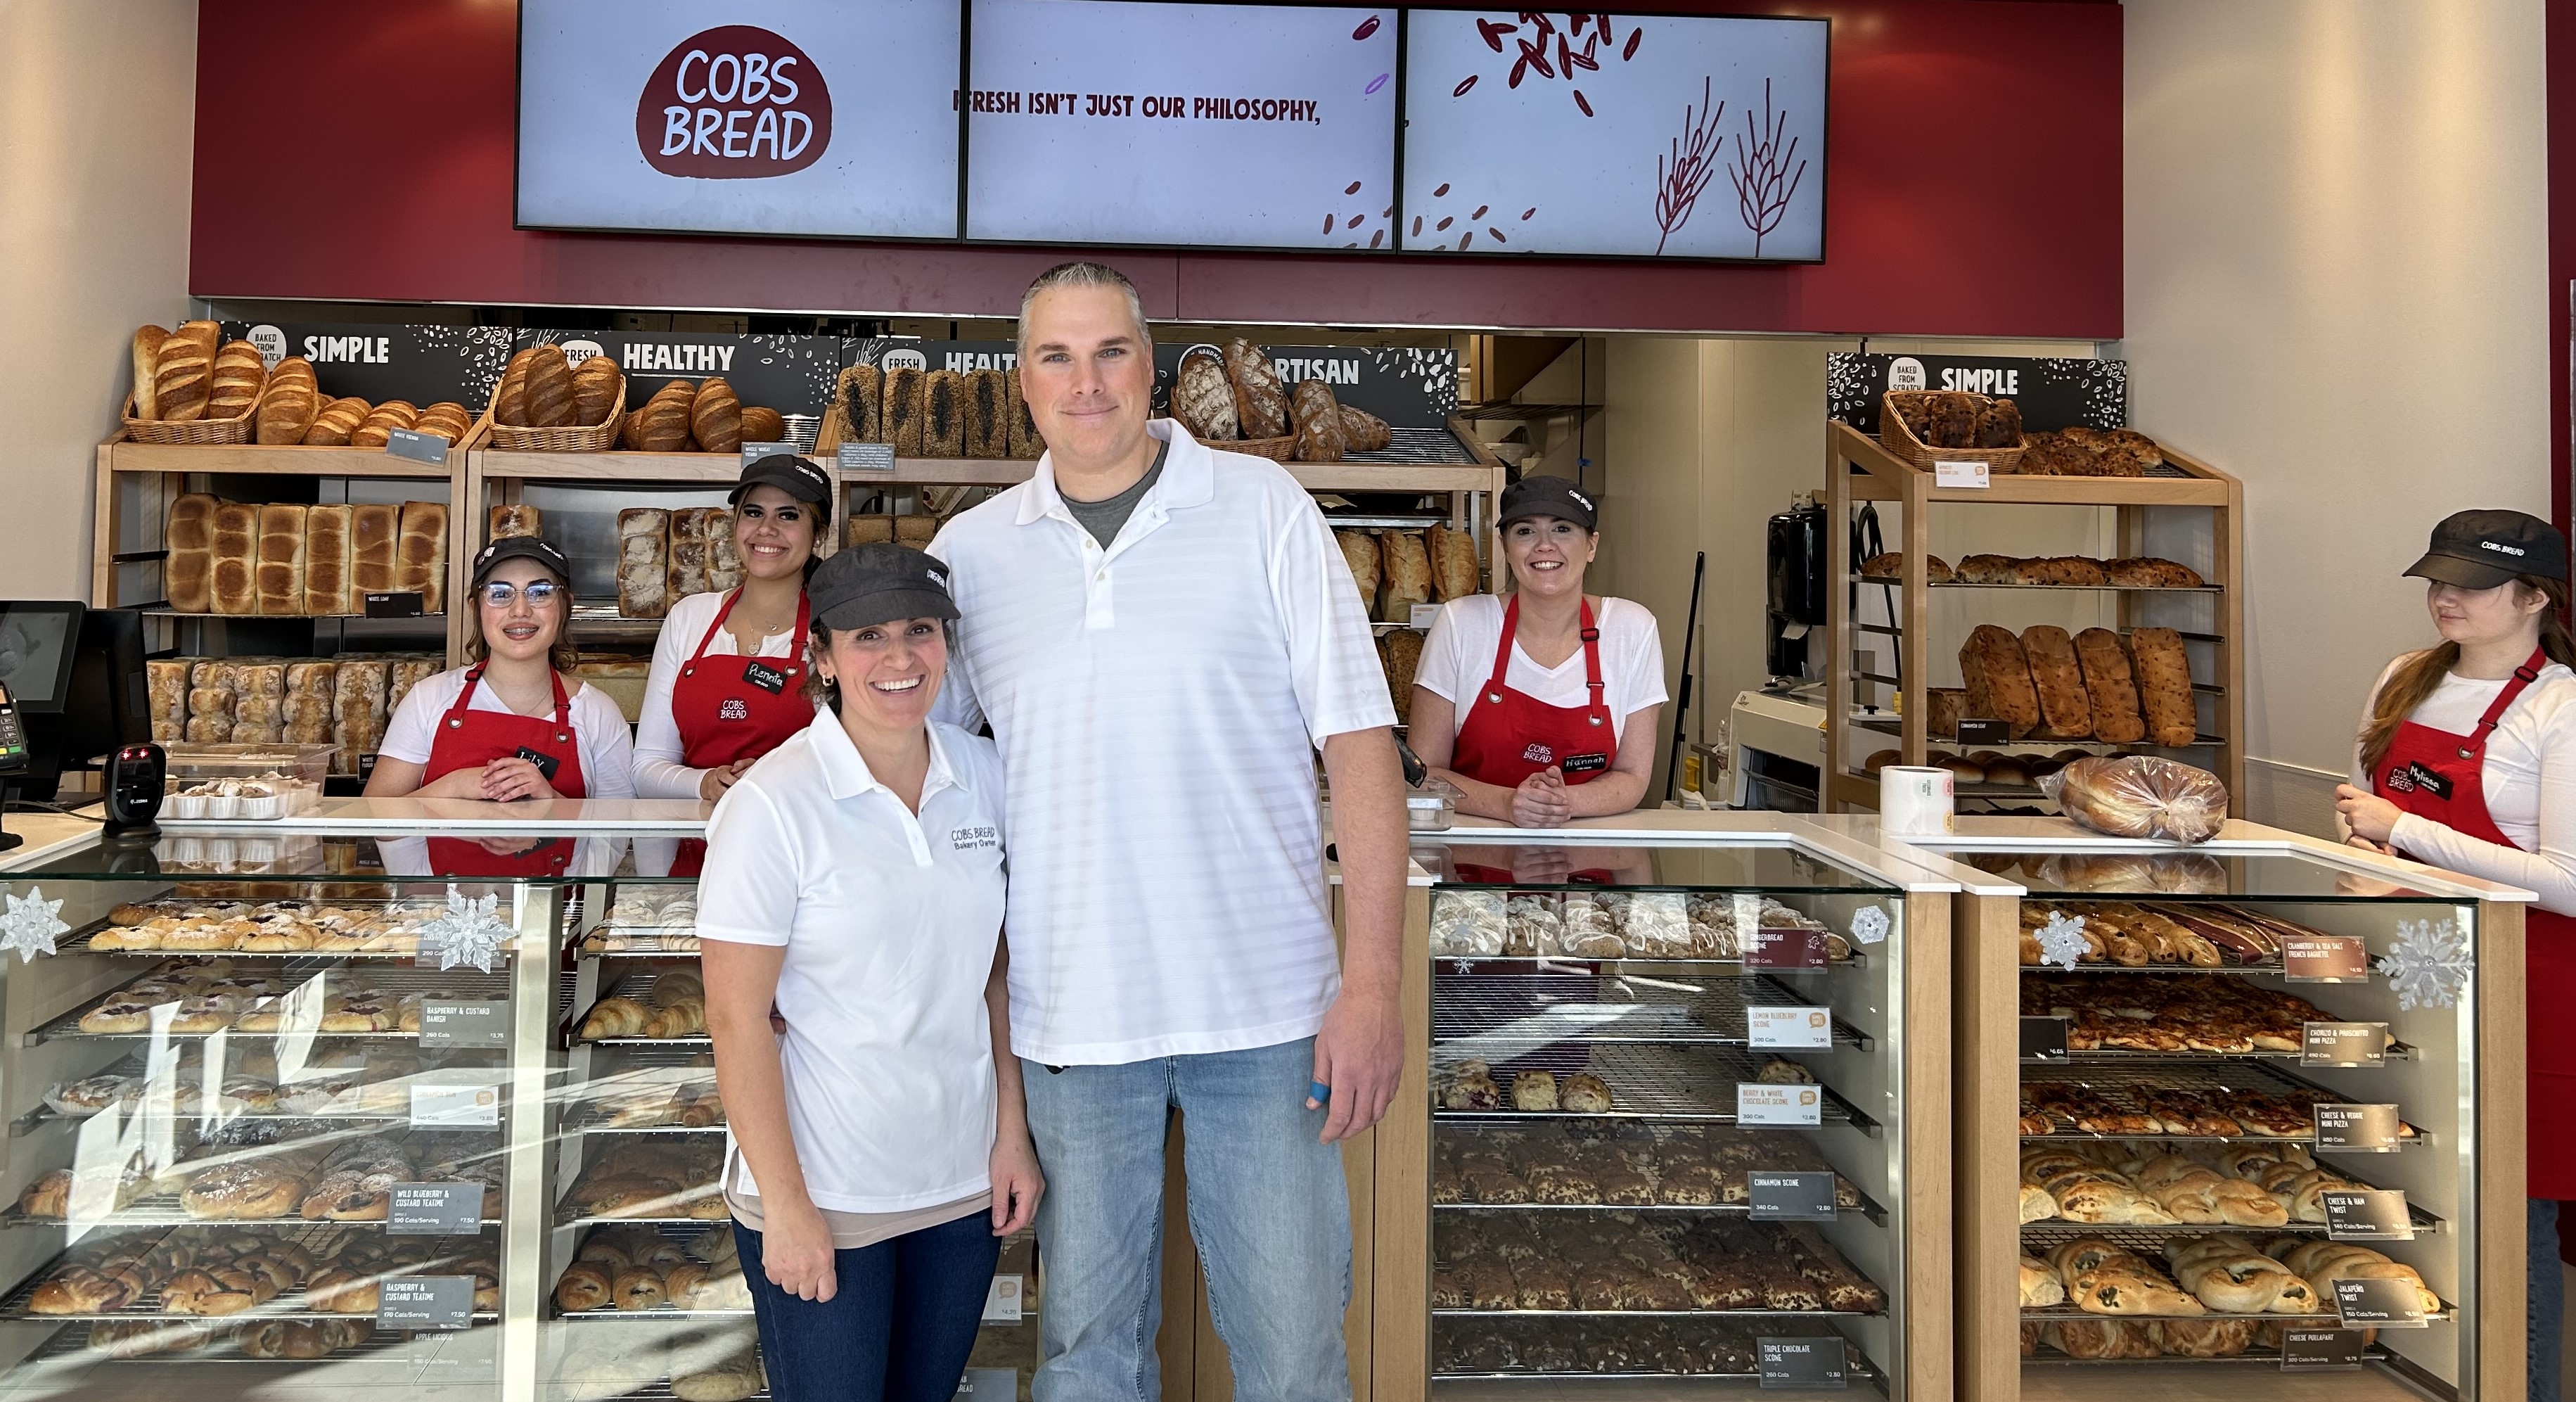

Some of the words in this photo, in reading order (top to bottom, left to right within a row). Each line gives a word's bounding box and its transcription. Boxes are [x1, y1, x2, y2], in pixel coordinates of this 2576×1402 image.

[677, 49, 799, 105] COBS
[1029, 92, 1077, 115] ISN'T
[1085, 94, 1134, 117] JUST
[1142, 96, 1186, 118] OUR
[1194, 97, 1321, 126] PHILOSOPHY,
[660, 106, 813, 161] BREAD
[255, 333, 277, 343] BAKED
[257, 343, 275, 352] FROM
[304, 336, 389, 363] SIMPLE
[261, 353, 281, 362] RATCH
[565, 349, 597, 362] FRESH
[624, 343, 736, 371] HEALTHY
[1198, 349, 1225, 367] HANDMAD
[889, 358, 920, 369] FRESH
[945, 352, 1018, 378] HEALT
[1274, 358, 1359, 385] RTISAN
[1897, 366, 1917, 374] BAKED
[1899, 375, 1915, 383] FROM
[1941, 367, 2018, 395] SIMPLE
[2481, 541, 2502, 552] COBS
[2501, 545, 2525, 556] BREAD
[748, 663, 783, 687] Renata
[723, 700, 745, 710] COBS
[720, 709, 747, 719] BREAD
[1527, 743, 1552, 755] COBS
[1523, 751, 1552, 763] BREAD
[1566, 756, 1605, 767] Hannah
[2409, 765, 2440, 789] Mylissa
[2388, 777, 2414, 792] BREAD
[951, 829, 973, 841] COBS
[973, 826, 995, 839] BREAD
[954, 841, 978, 850] Bakery
[426, 1007, 457, 1015] RASPBERRY
[459, 1007, 464, 1015] &
[1754, 1178, 1781, 1187] CINNAMON
[397, 1190, 411, 1198] WILD
[413, 1190, 442, 1198] BLUEBERRY
[422, 1199, 444, 1207] TEATIME
[386, 1283, 419, 1292] RASPBERRY
[420, 1283, 425, 1292] &
[2338, 1283, 2364, 1293] JALAPEÑO
[412, 1293, 435, 1301] TEATIME
[1763, 1344, 1781, 1353] TRIPLE
[1782, 1344, 1811, 1353] CHOCOLATE
[1764, 1353, 1783, 1362] SCONE
